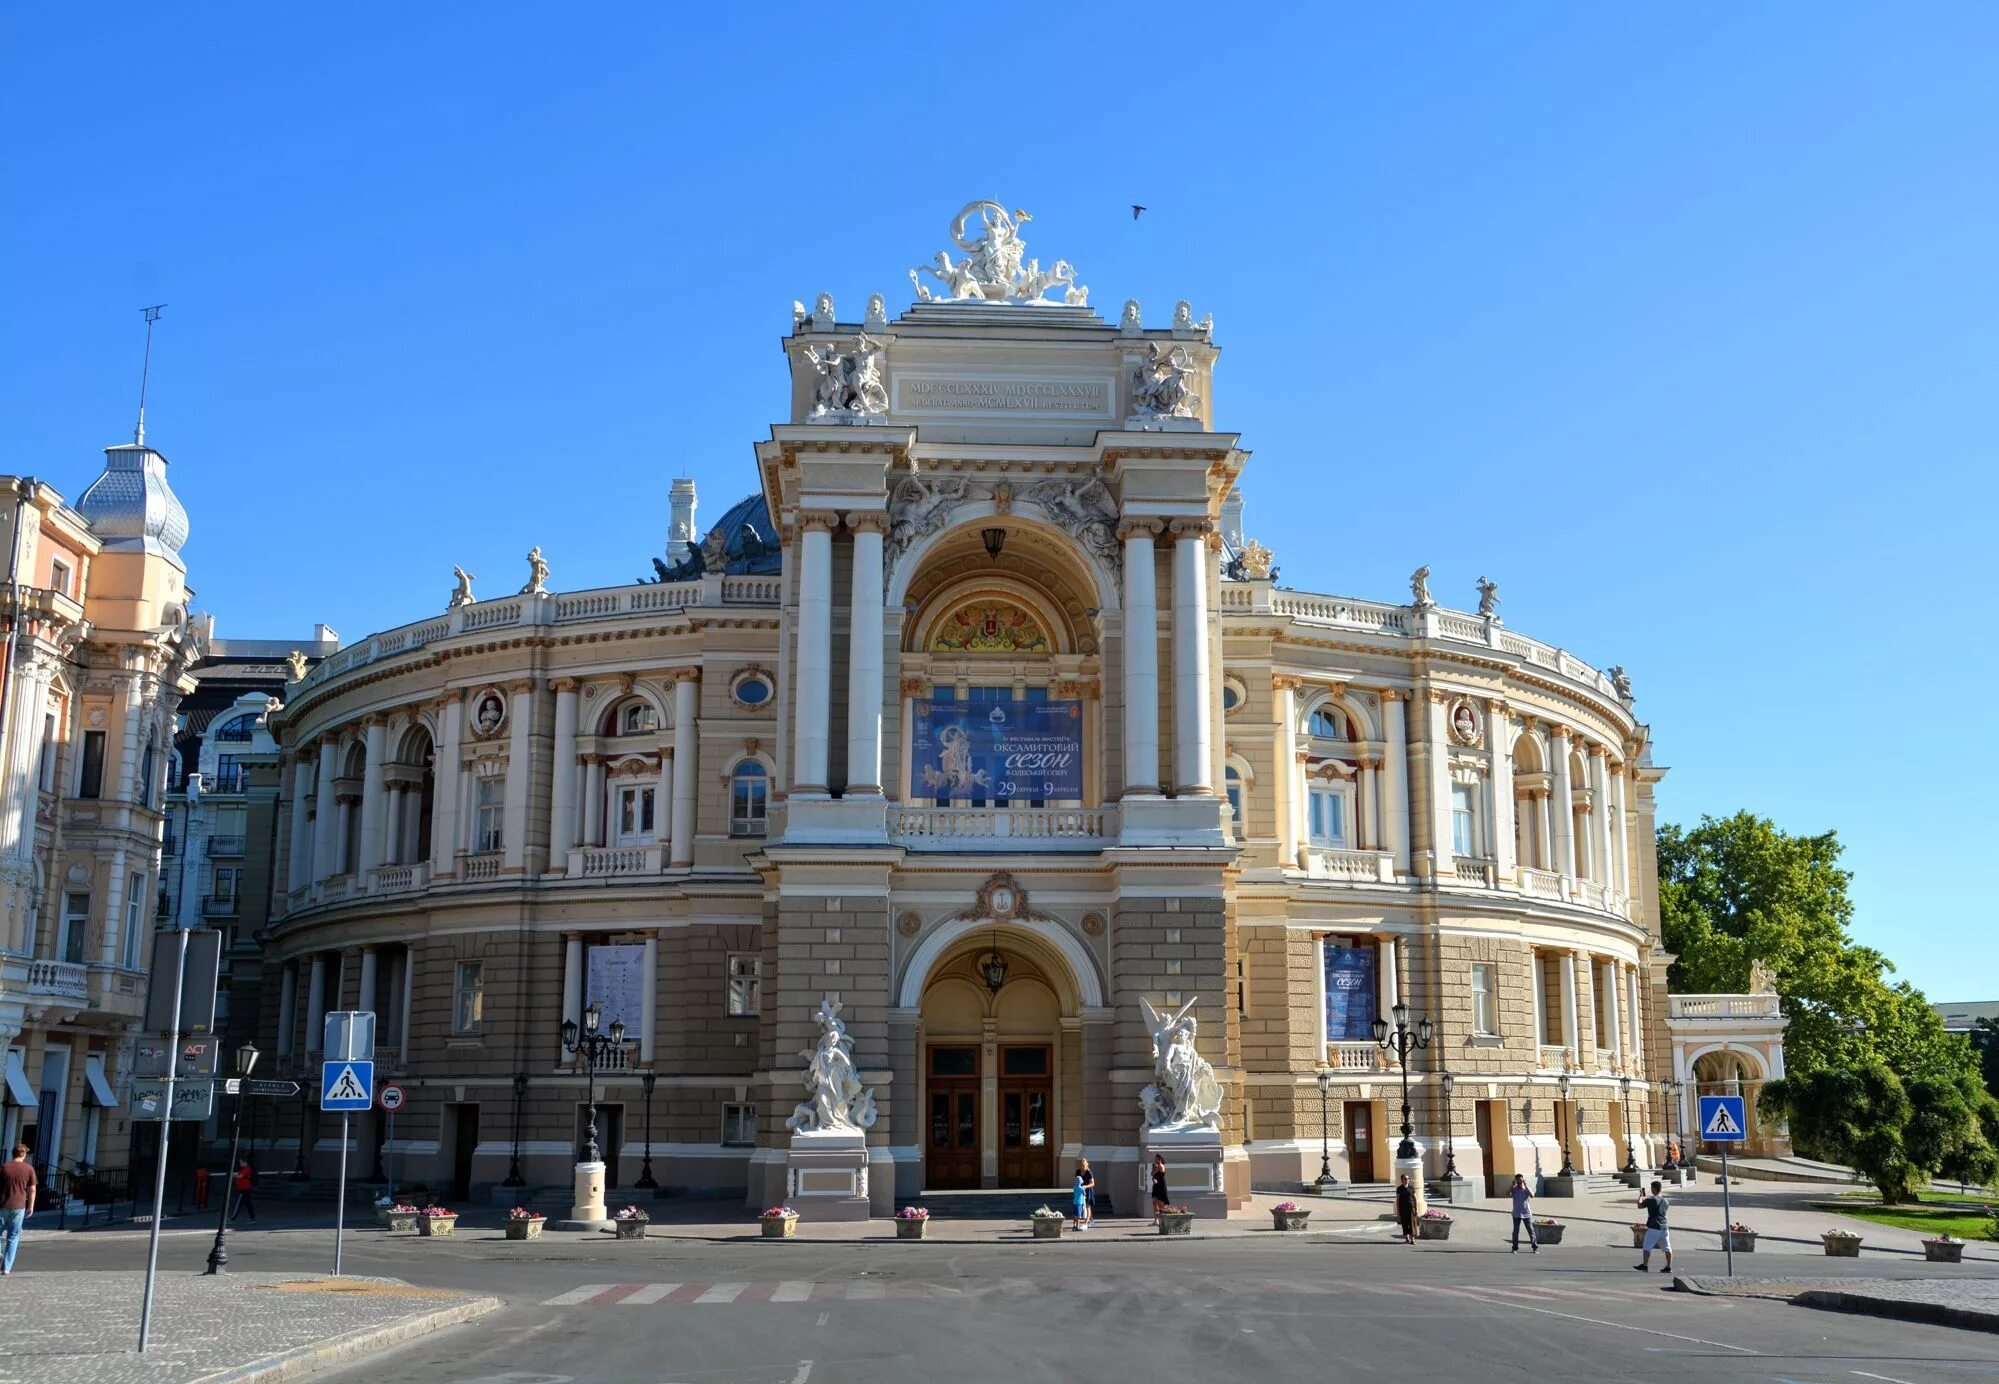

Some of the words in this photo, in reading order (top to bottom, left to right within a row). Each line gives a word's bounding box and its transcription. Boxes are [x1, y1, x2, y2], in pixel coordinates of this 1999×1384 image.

[978, 397, 1038, 409] MCMLXVII
[993, 742, 1079, 752] ОКСАМИТОВИЙ
[997, 781, 1016, 796] 29
[1043, 781, 1054, 796] 9
